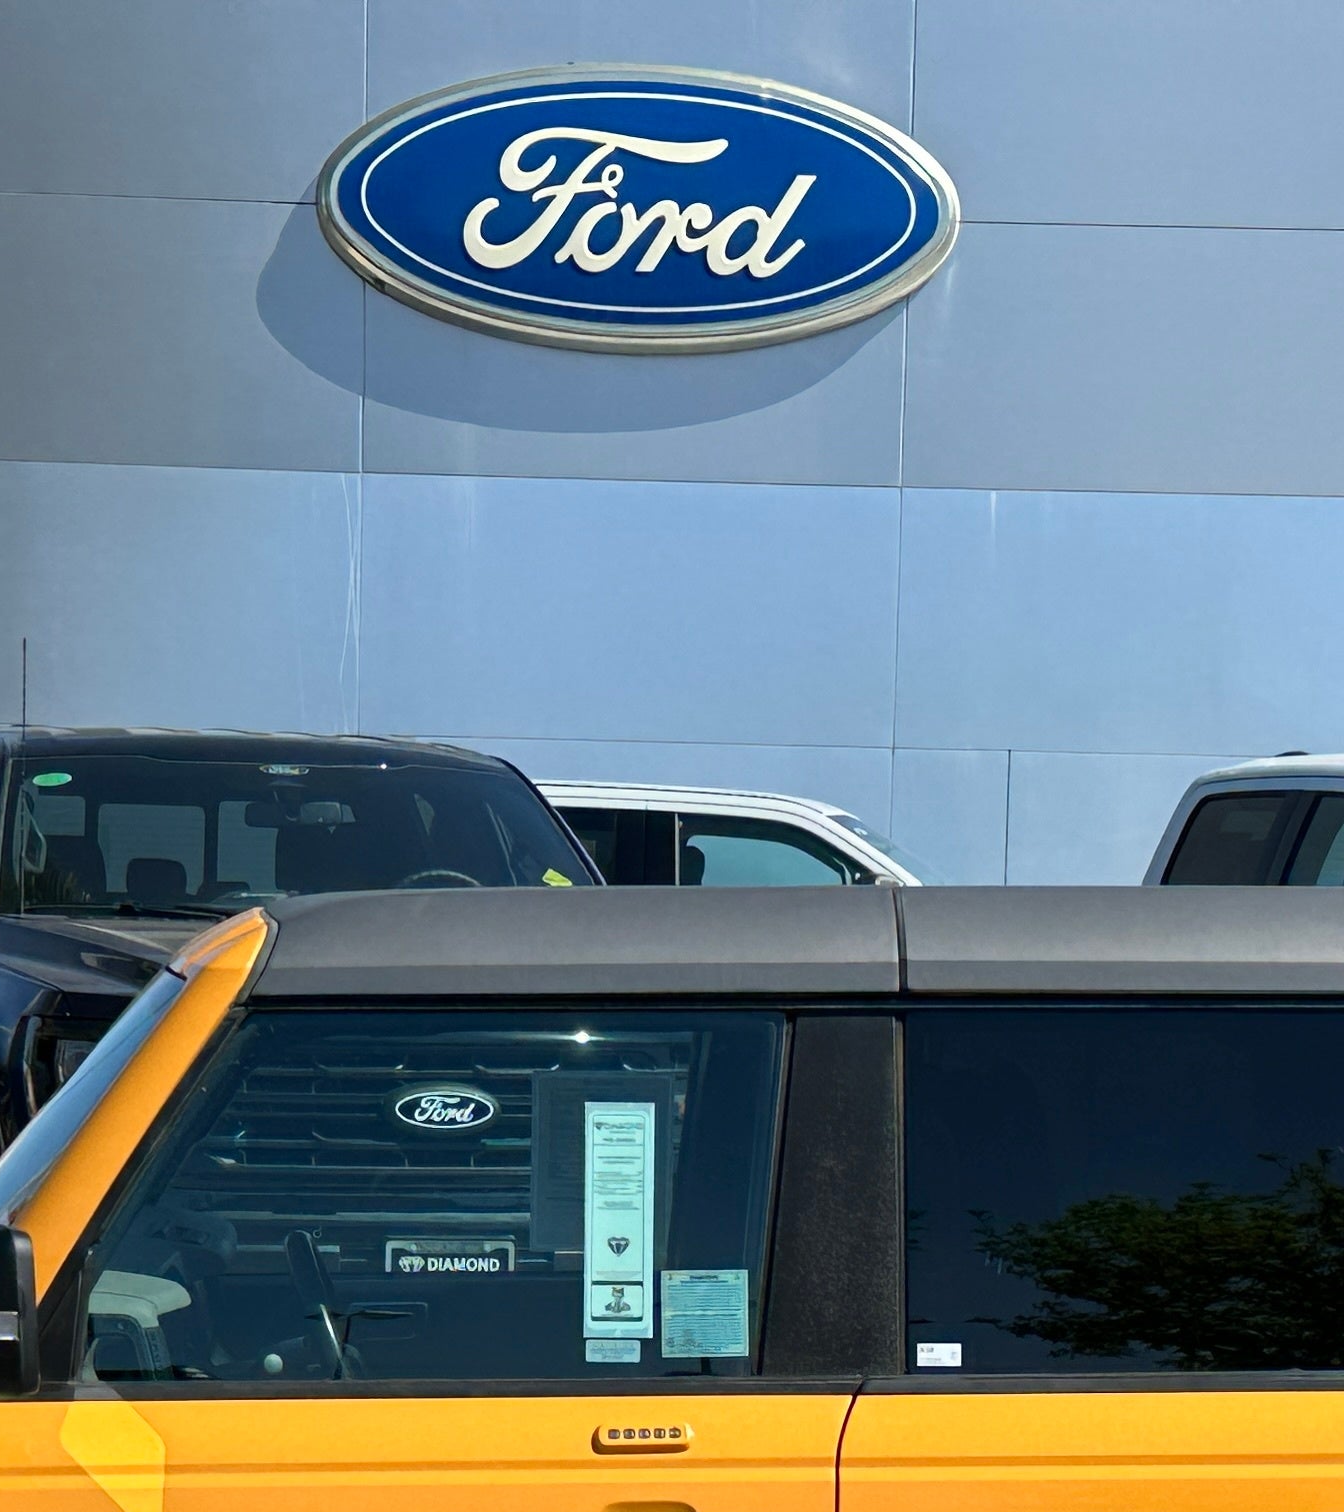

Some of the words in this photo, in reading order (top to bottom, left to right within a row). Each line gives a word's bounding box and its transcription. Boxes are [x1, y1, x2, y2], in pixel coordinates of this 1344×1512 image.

[462, 126, 817, 279] Ford
[414, 1096, 475, 1122] Ford
[427, 1257, 500, 1272] DIAMOND
